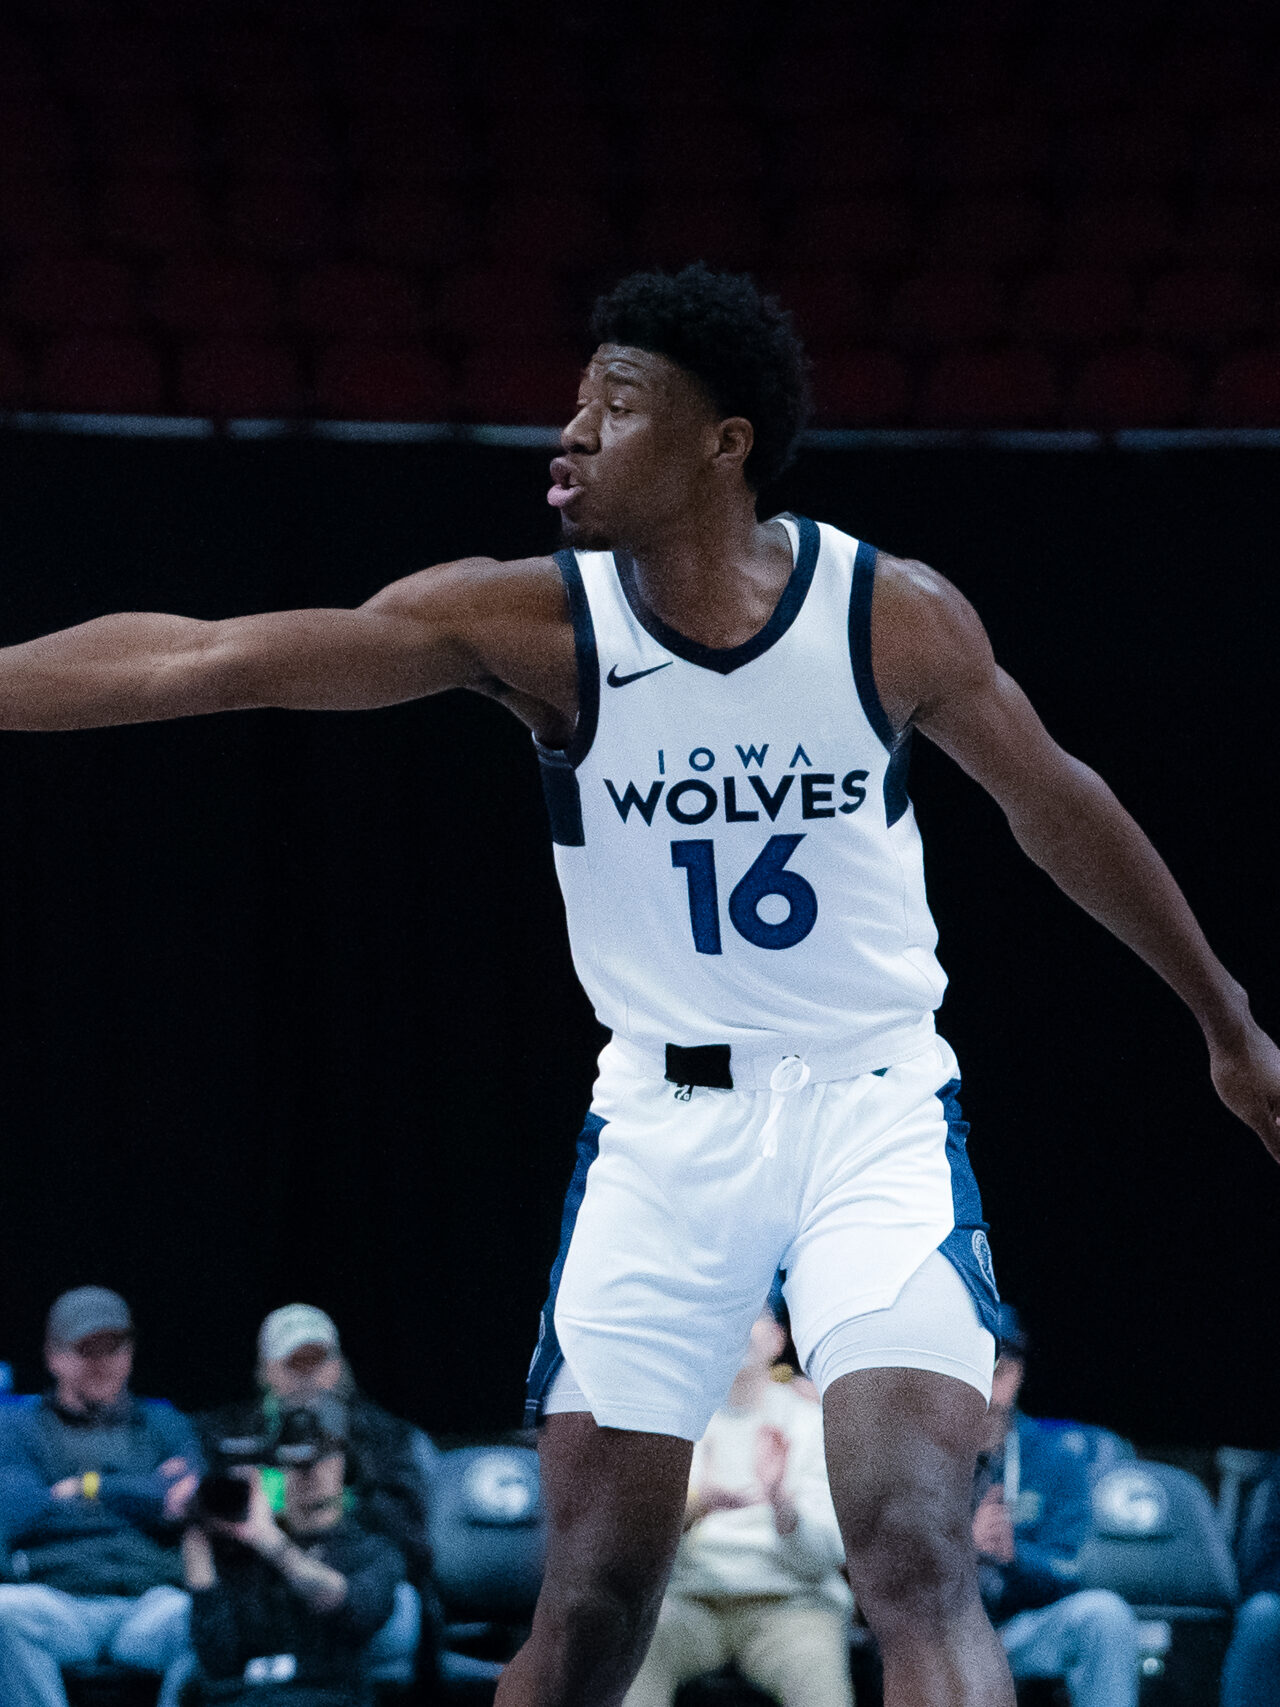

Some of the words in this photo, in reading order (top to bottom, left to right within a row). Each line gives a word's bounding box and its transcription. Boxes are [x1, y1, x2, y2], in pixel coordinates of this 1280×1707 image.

[657, 743, 813, 775] IOWA
[603, 769, 871, 827] WOLVES
[670, 833, 819, 956] 16
